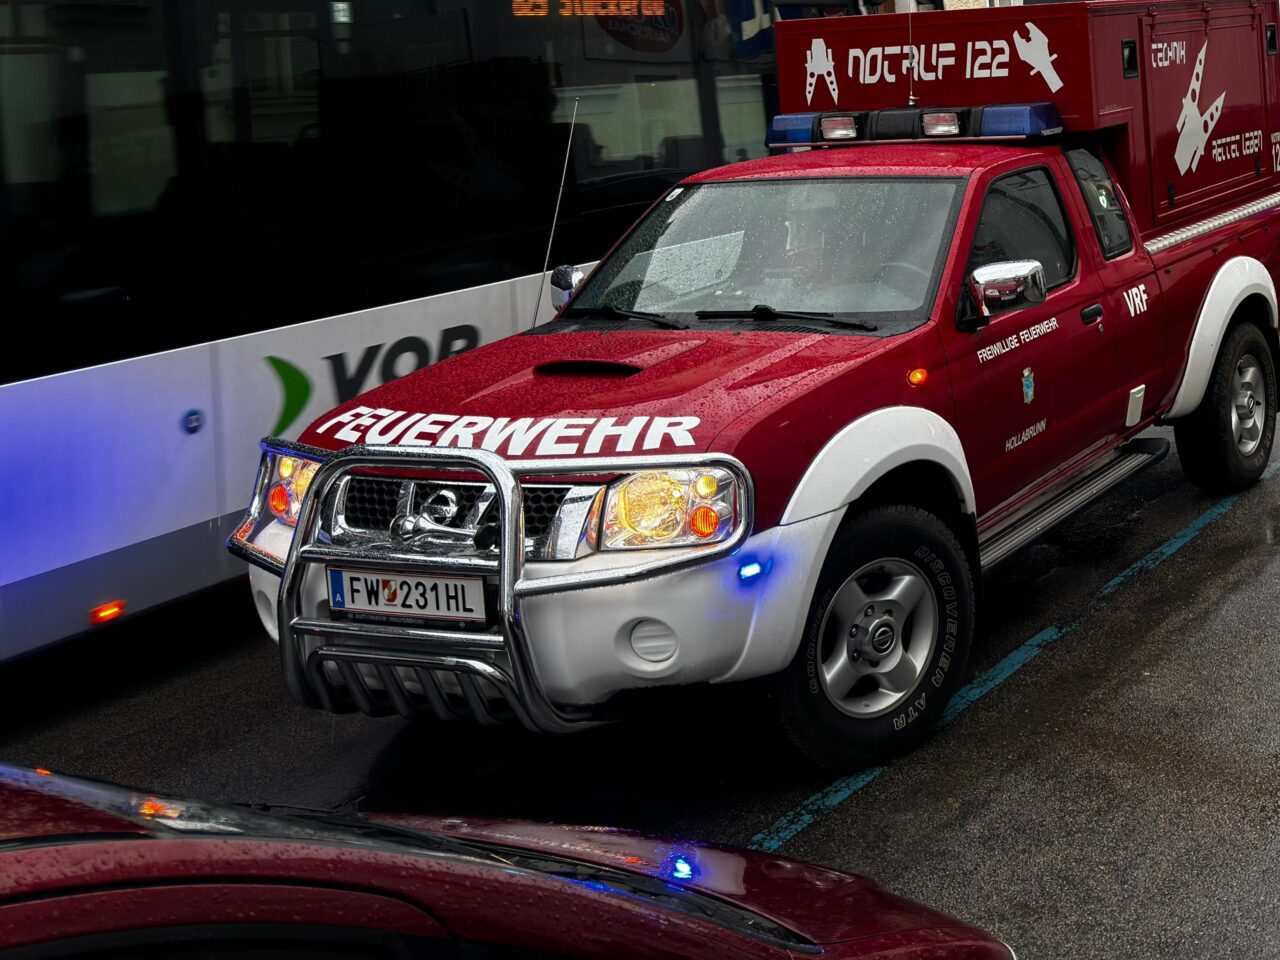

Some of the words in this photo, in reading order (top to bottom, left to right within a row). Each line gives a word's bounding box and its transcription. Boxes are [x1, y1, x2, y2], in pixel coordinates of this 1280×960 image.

[848, 42, 956, 84] NOTRUF
[965, 40, 1010, 79] 122
[1151, 41, 1186, 68] TECHNIK
[1212, 135, 1240, 162] RETTET
[1241, 130, 1263, 156] LEBEN
[1123, 284, 1148, 317] VRF
[977, 334, 1020, 364] FREIWILLIGE
[1019, 317, 1059, 344] FEUERWEHR
[315, 404, 702, 457] FEUERWEHR
[1005, 418, 1047, 452] HOLLABRUNN
[335, 594, 343, 602] A
[349, 576, 379, 606] FW
[399, 580, 474, 613] 231HL
[914, 546, 958, 687] DISCOVERER
[893, 692, 926, 730] ATR
